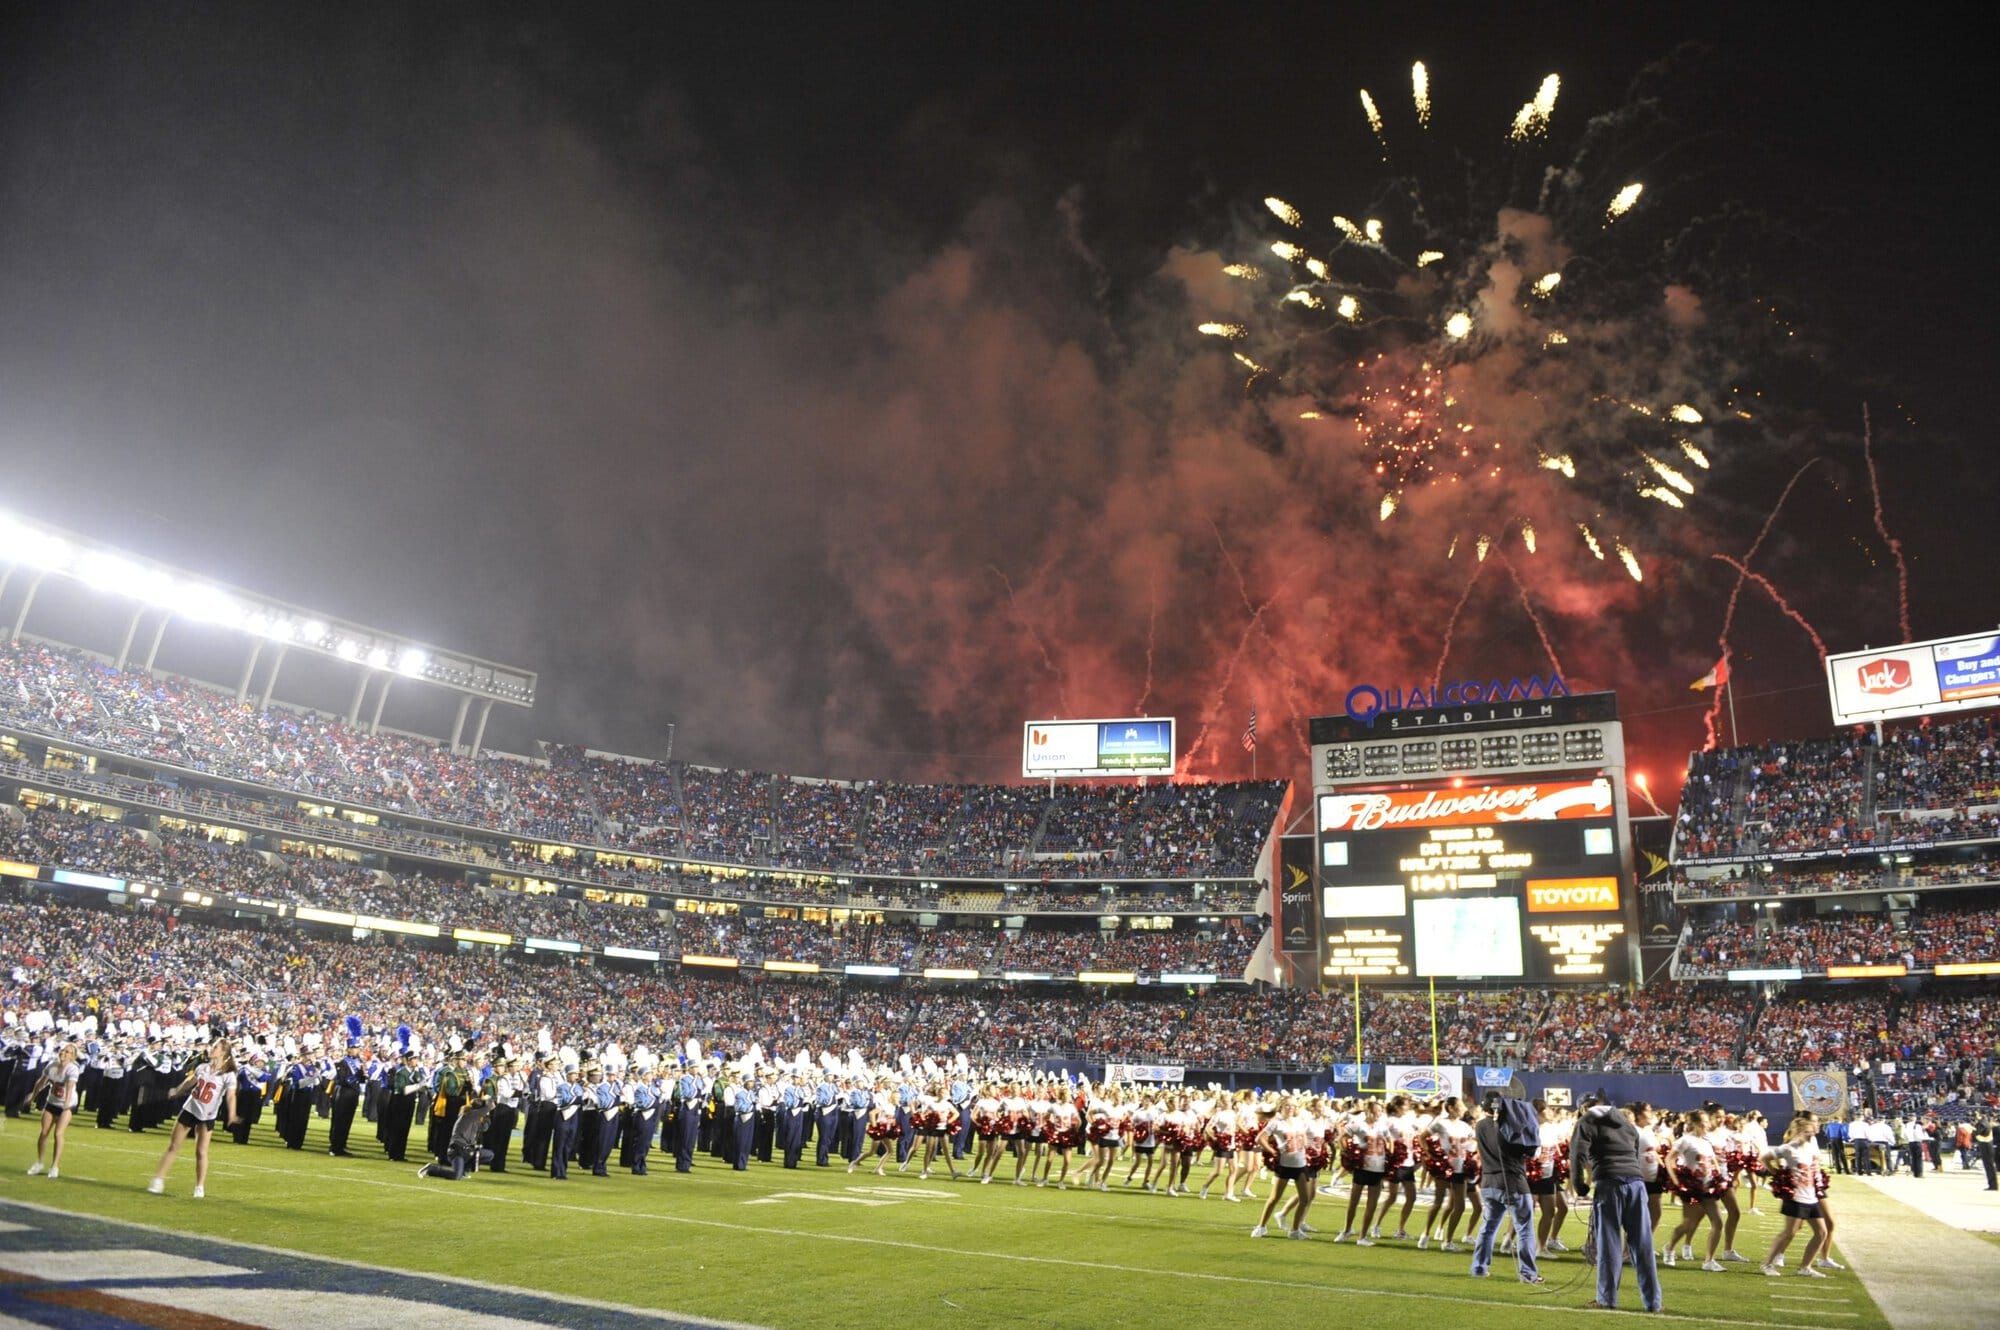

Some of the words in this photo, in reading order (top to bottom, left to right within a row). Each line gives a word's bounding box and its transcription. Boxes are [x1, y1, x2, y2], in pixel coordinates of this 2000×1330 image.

[1957, 660, 1978, 671] Buy
[1391, 705, 1552, 728] STADIUM
[1032, 753, 1066, 762] Union
[1348, 786, 1537, 831] Budweiser
[1531, 886, 1615, 904] TOYOTA
[1638, 881, 1674, 894] Sprint
[1282, 892, 1312, 904] Sprint
[1112, 1065, 1127, 1081] A
[1757, 1073, 1780, 1092] N
